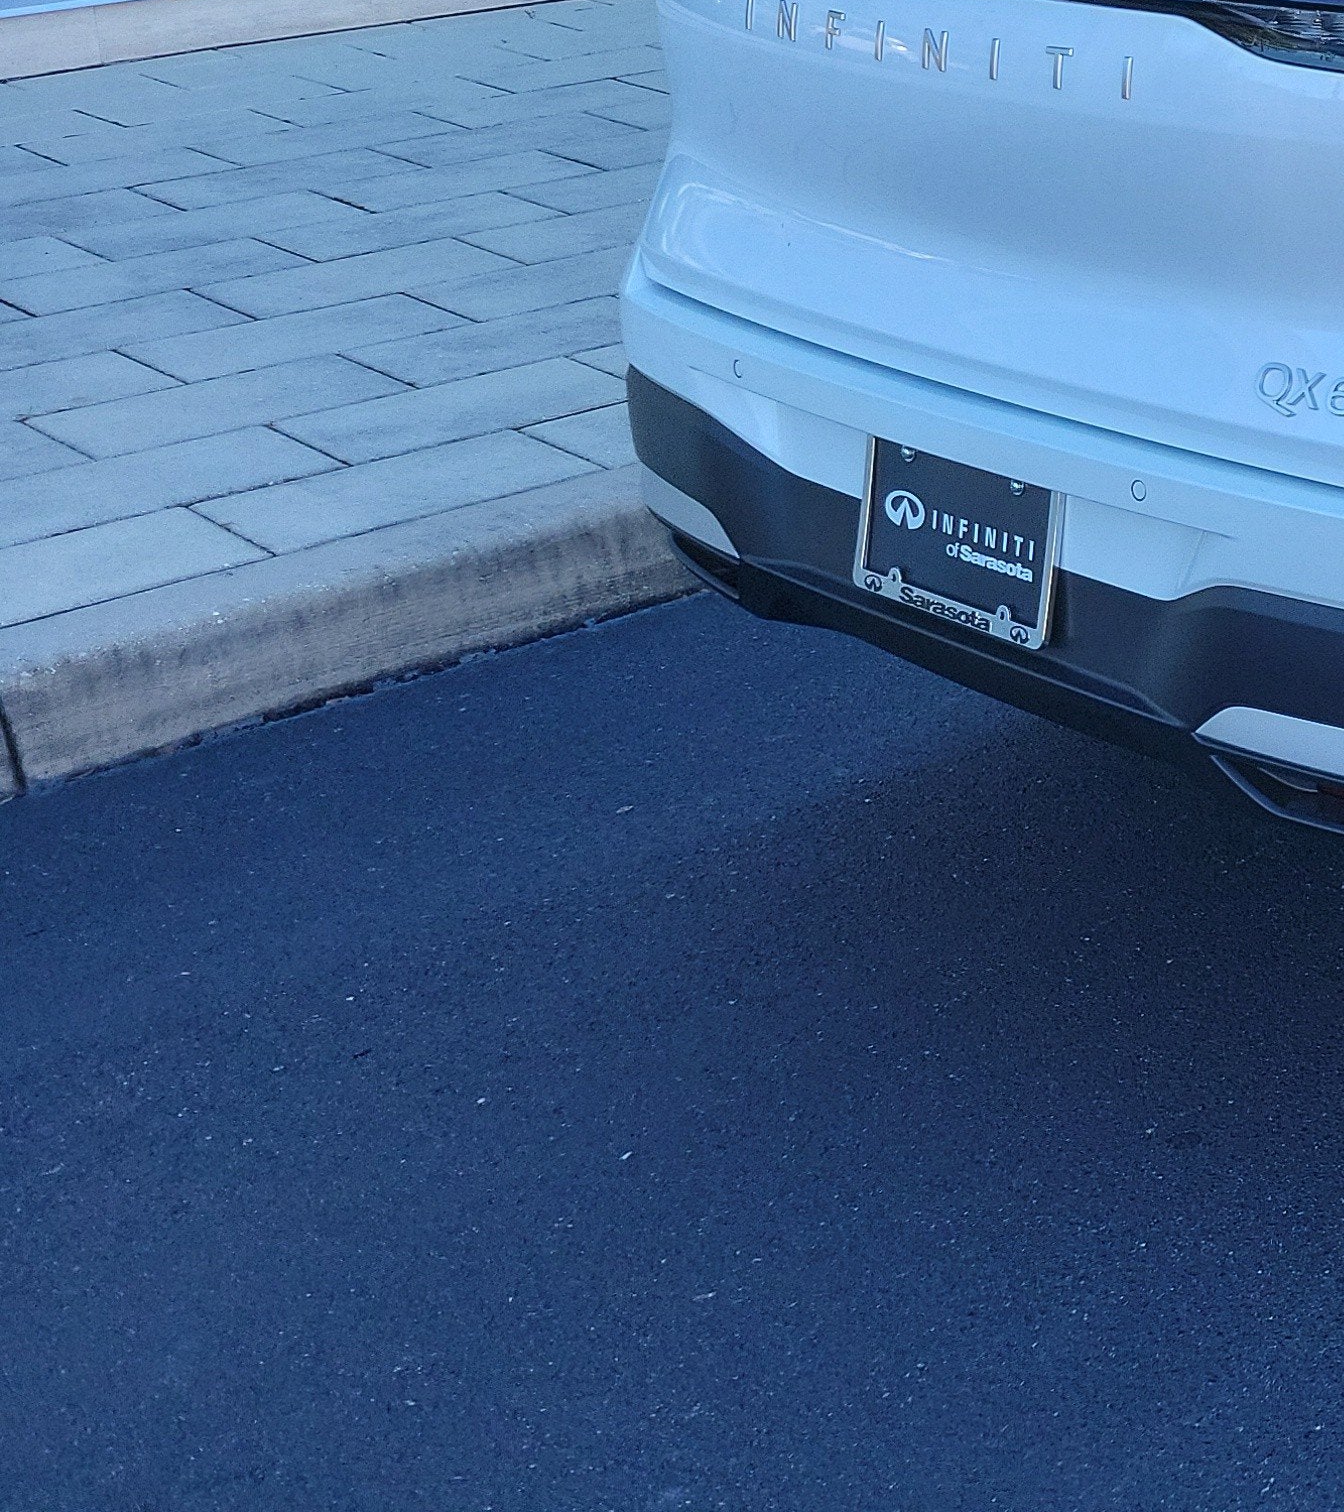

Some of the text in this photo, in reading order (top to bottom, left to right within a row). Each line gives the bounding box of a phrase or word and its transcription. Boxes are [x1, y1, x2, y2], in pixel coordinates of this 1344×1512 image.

[932, 509, 1035, 562] INFINITI
[960, 544, 1033, 583] Sarasota
[899, 586, 990, 633] Sarasota
